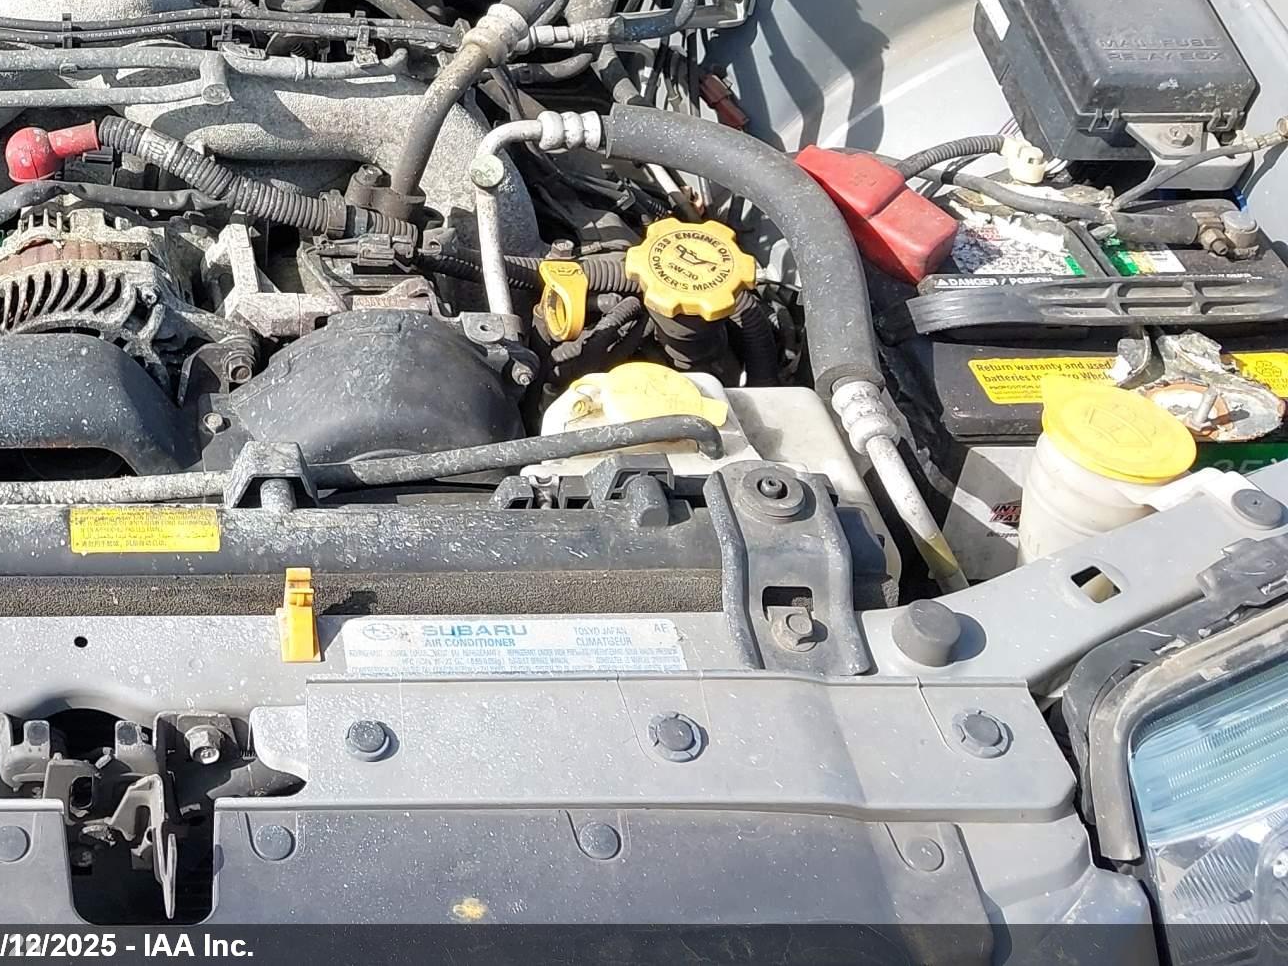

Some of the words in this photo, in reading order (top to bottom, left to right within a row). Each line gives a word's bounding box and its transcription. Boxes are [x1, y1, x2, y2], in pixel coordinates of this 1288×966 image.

[654, 238, 671, 254] SEE
[675, 232, 720, 248] ENGINE
[718, 247, 731, 262] OIL
[652, 255, 689, 290] OWNER'S
[668, 262, 699, 281] 5W-30
[692, 268, 731, 291] MANUAL
[949, 277, 999, 286] DANGER
[976, 362, 1013, 372] Return
[1014, 361, 1062, 372] warranty
[1064, 361, 1085, 370] and
[1086, 360, 1112, 370] used
[983, 373, 1031, 383] batteries
[992, 504, 1022, 513] INT
[421, 624, 528, 637] SUBARU
[424, 638, 443, 648] AIR
[444, 638, 517, 648] CONDITIONER
